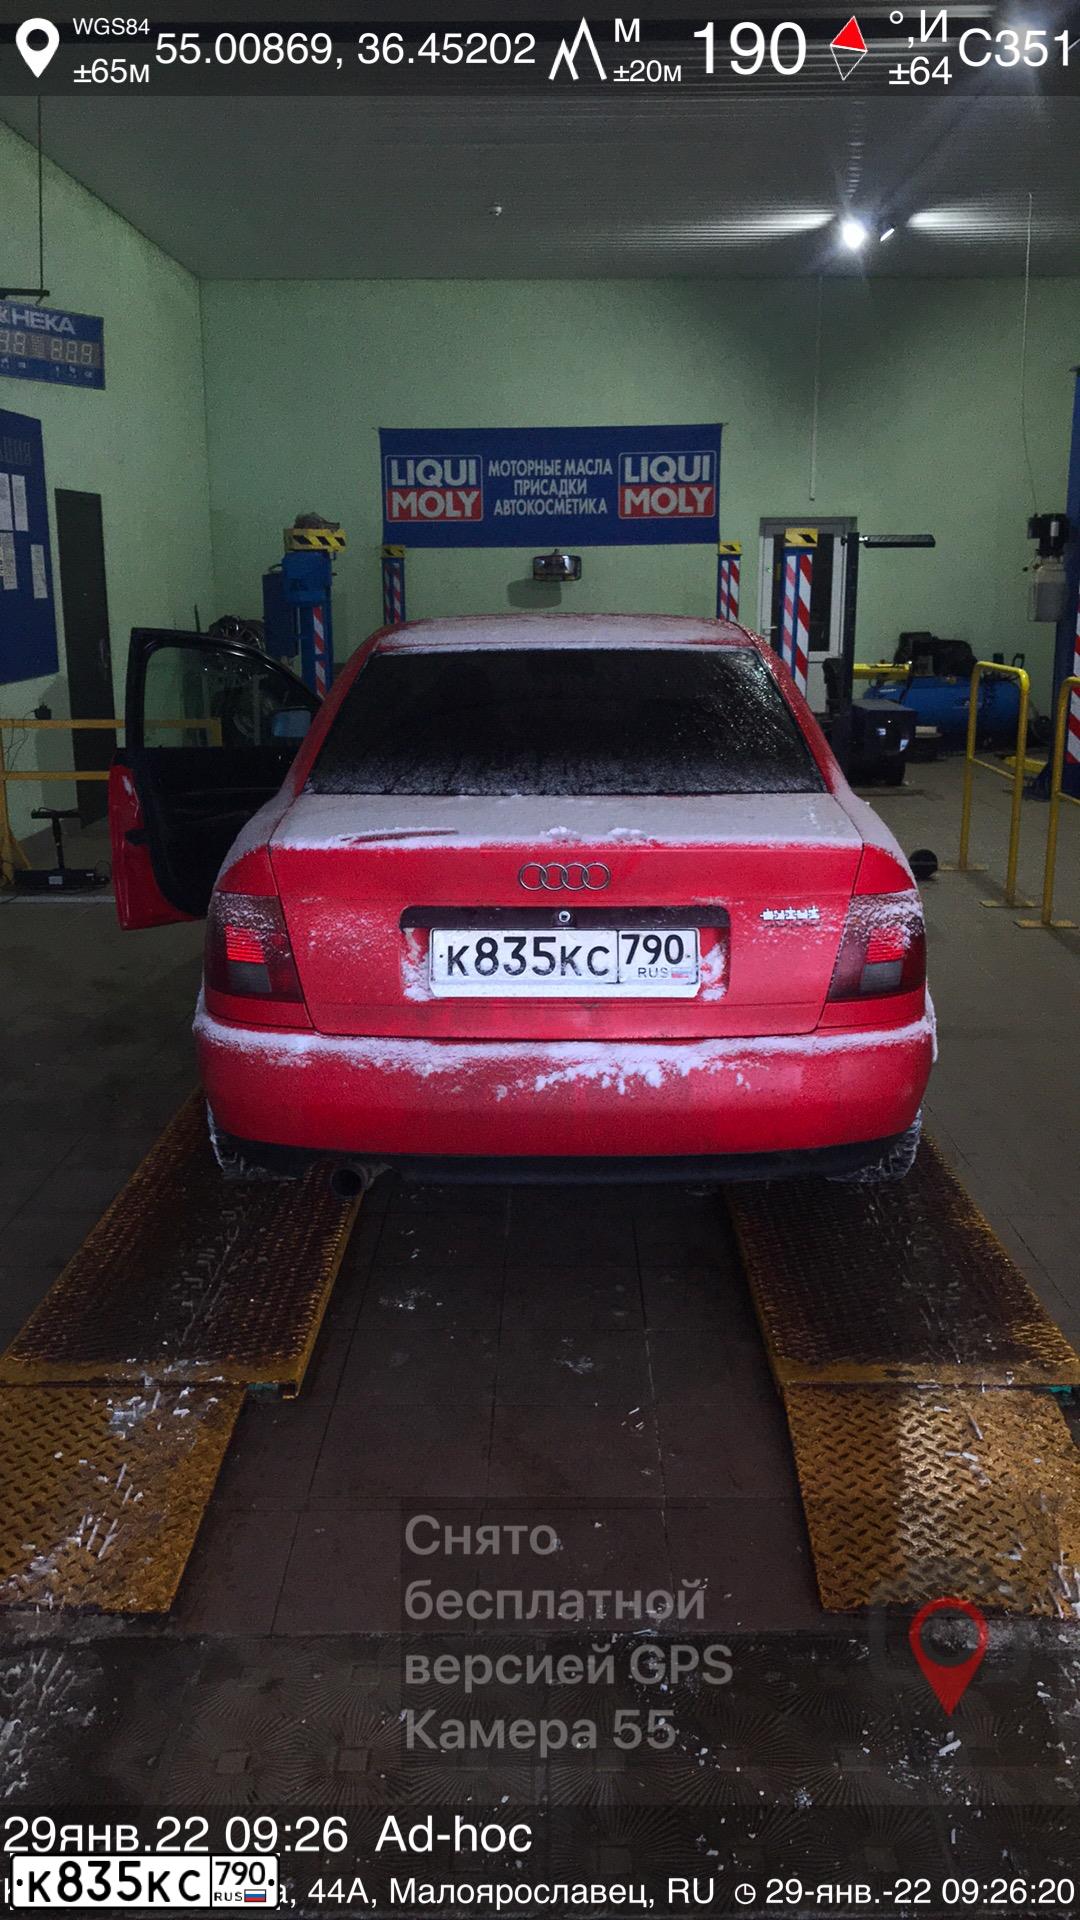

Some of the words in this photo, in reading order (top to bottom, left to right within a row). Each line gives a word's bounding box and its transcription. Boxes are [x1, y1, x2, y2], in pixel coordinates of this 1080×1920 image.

[390, 458, 478, 487] LIQUI
[488, 459, 562, 477] МОТОРНЫЕ
[564, 458, 614, 475] МАСЛА
[623, 454, 711, 484] LIQUI
[513, 478, 588, 498] ПРИСАДКИ
[623, 486, 713, 515] MOLY
[391, 490, 480, 518] MOLY
[493, 497, 609, 516] АВТОКОСМЕТИКА
[620, 933, 684, 965] 790
[637, 966, 669, 979] RUS
